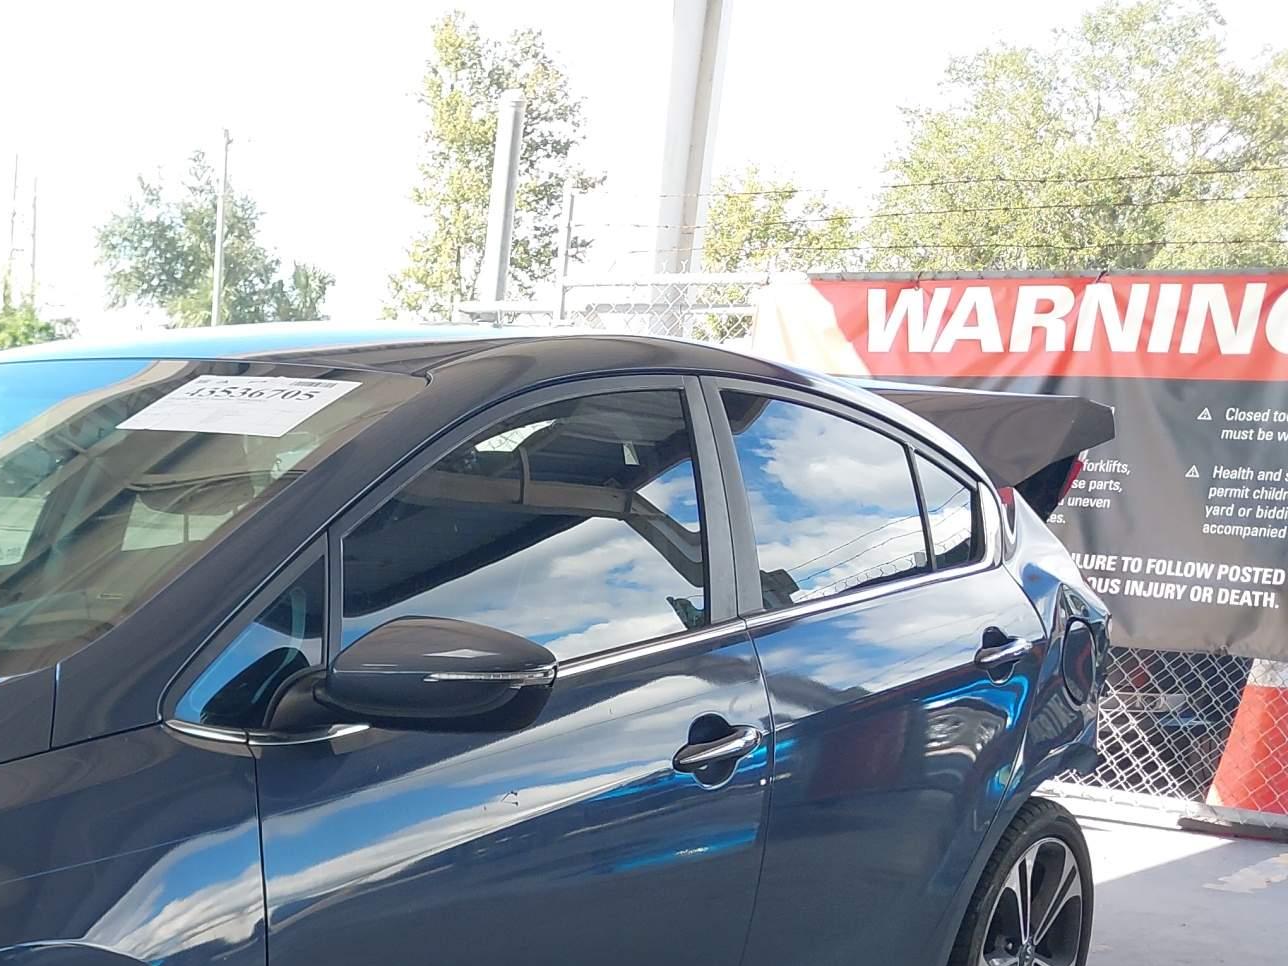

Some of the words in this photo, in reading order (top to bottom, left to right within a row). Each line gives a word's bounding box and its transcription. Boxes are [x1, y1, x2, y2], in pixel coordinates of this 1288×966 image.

[1225, 407, 1271, 421] Closed
[1273, 410, 1288, 422] to
[1221, 428, 1255, 441] must
[1257, 427, 1274, 441] be
[1082, 459, 1131, 475] forklifts,
[1212, 465, 1254, 480] Health
[1257, 468, 1282, 482] and
[1088, 479, 1123, 493] parts,
[1208, 485, 1250, 499] permit
[1067, 496, 1111, 509] uneven
[1204, 504, 1234, 518] yard
[1237, 506, 1253, 518] or
[1202, 523, 1288, 540] accompanied
[1121, 556, 1143, 574] TO
[1145, 558, 1214, 579] FOLLOW
[1216, 564, 1286, 586] POSTED
[1123, 579, 1187, 600] INJURY
[1189, 585, 1213, 604] OR
[1216, 588, 1280, 609] DEATH.
